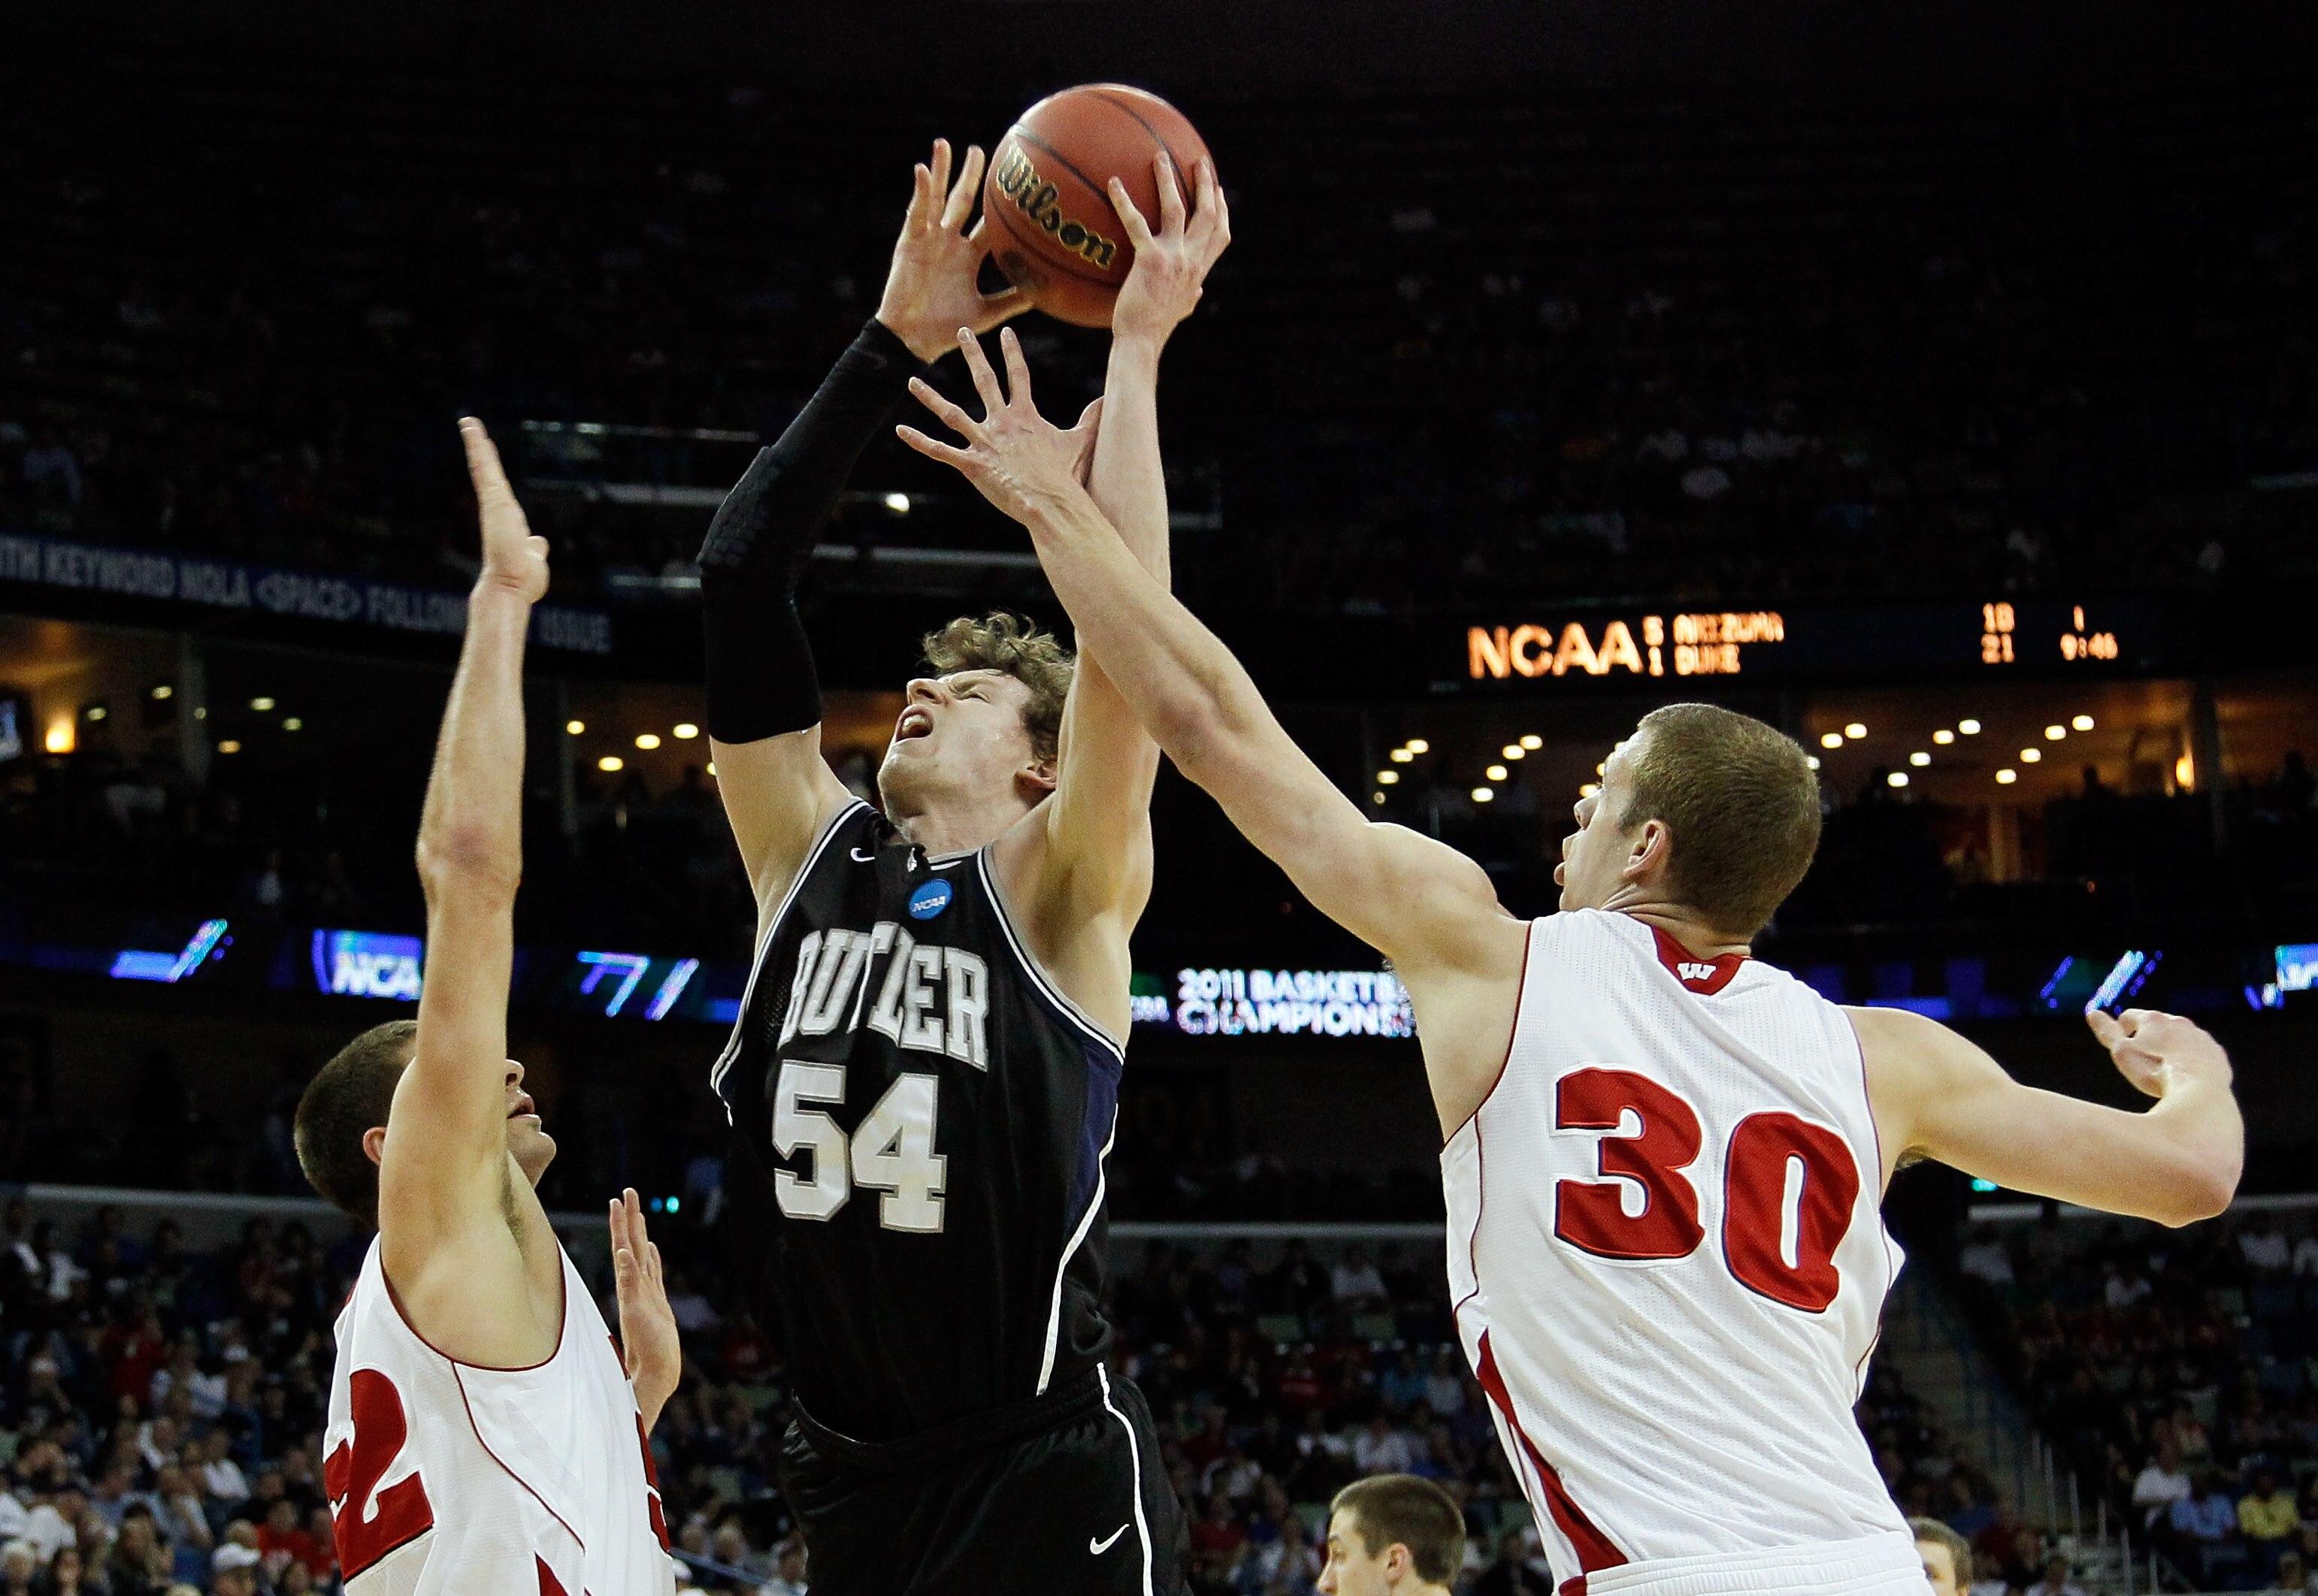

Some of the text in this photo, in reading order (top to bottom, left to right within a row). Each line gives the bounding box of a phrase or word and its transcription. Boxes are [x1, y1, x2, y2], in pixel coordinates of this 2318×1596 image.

[997, 141, 1117, 271] Wilson
[44, 542, 175, 599] KEYWORD
[180, 561, 251, 607] NOLA
[537, 606, 610, 654] ISSUE
[1468, 619, 1644, 679] NCAA
[1648, 646, 1664, 676] 1
[1981, 633, 2015, 664] 21
[911, 895, 947, 912] NCAA
[331, 951, 423, 1000] NCA
[776, 920, 988, 1072] BUTLER
[1178, 968, 1245, 1001] 2011
[772, 1058, 947, 1233] 54
[1553, 1064, 1862, 1315] 30
